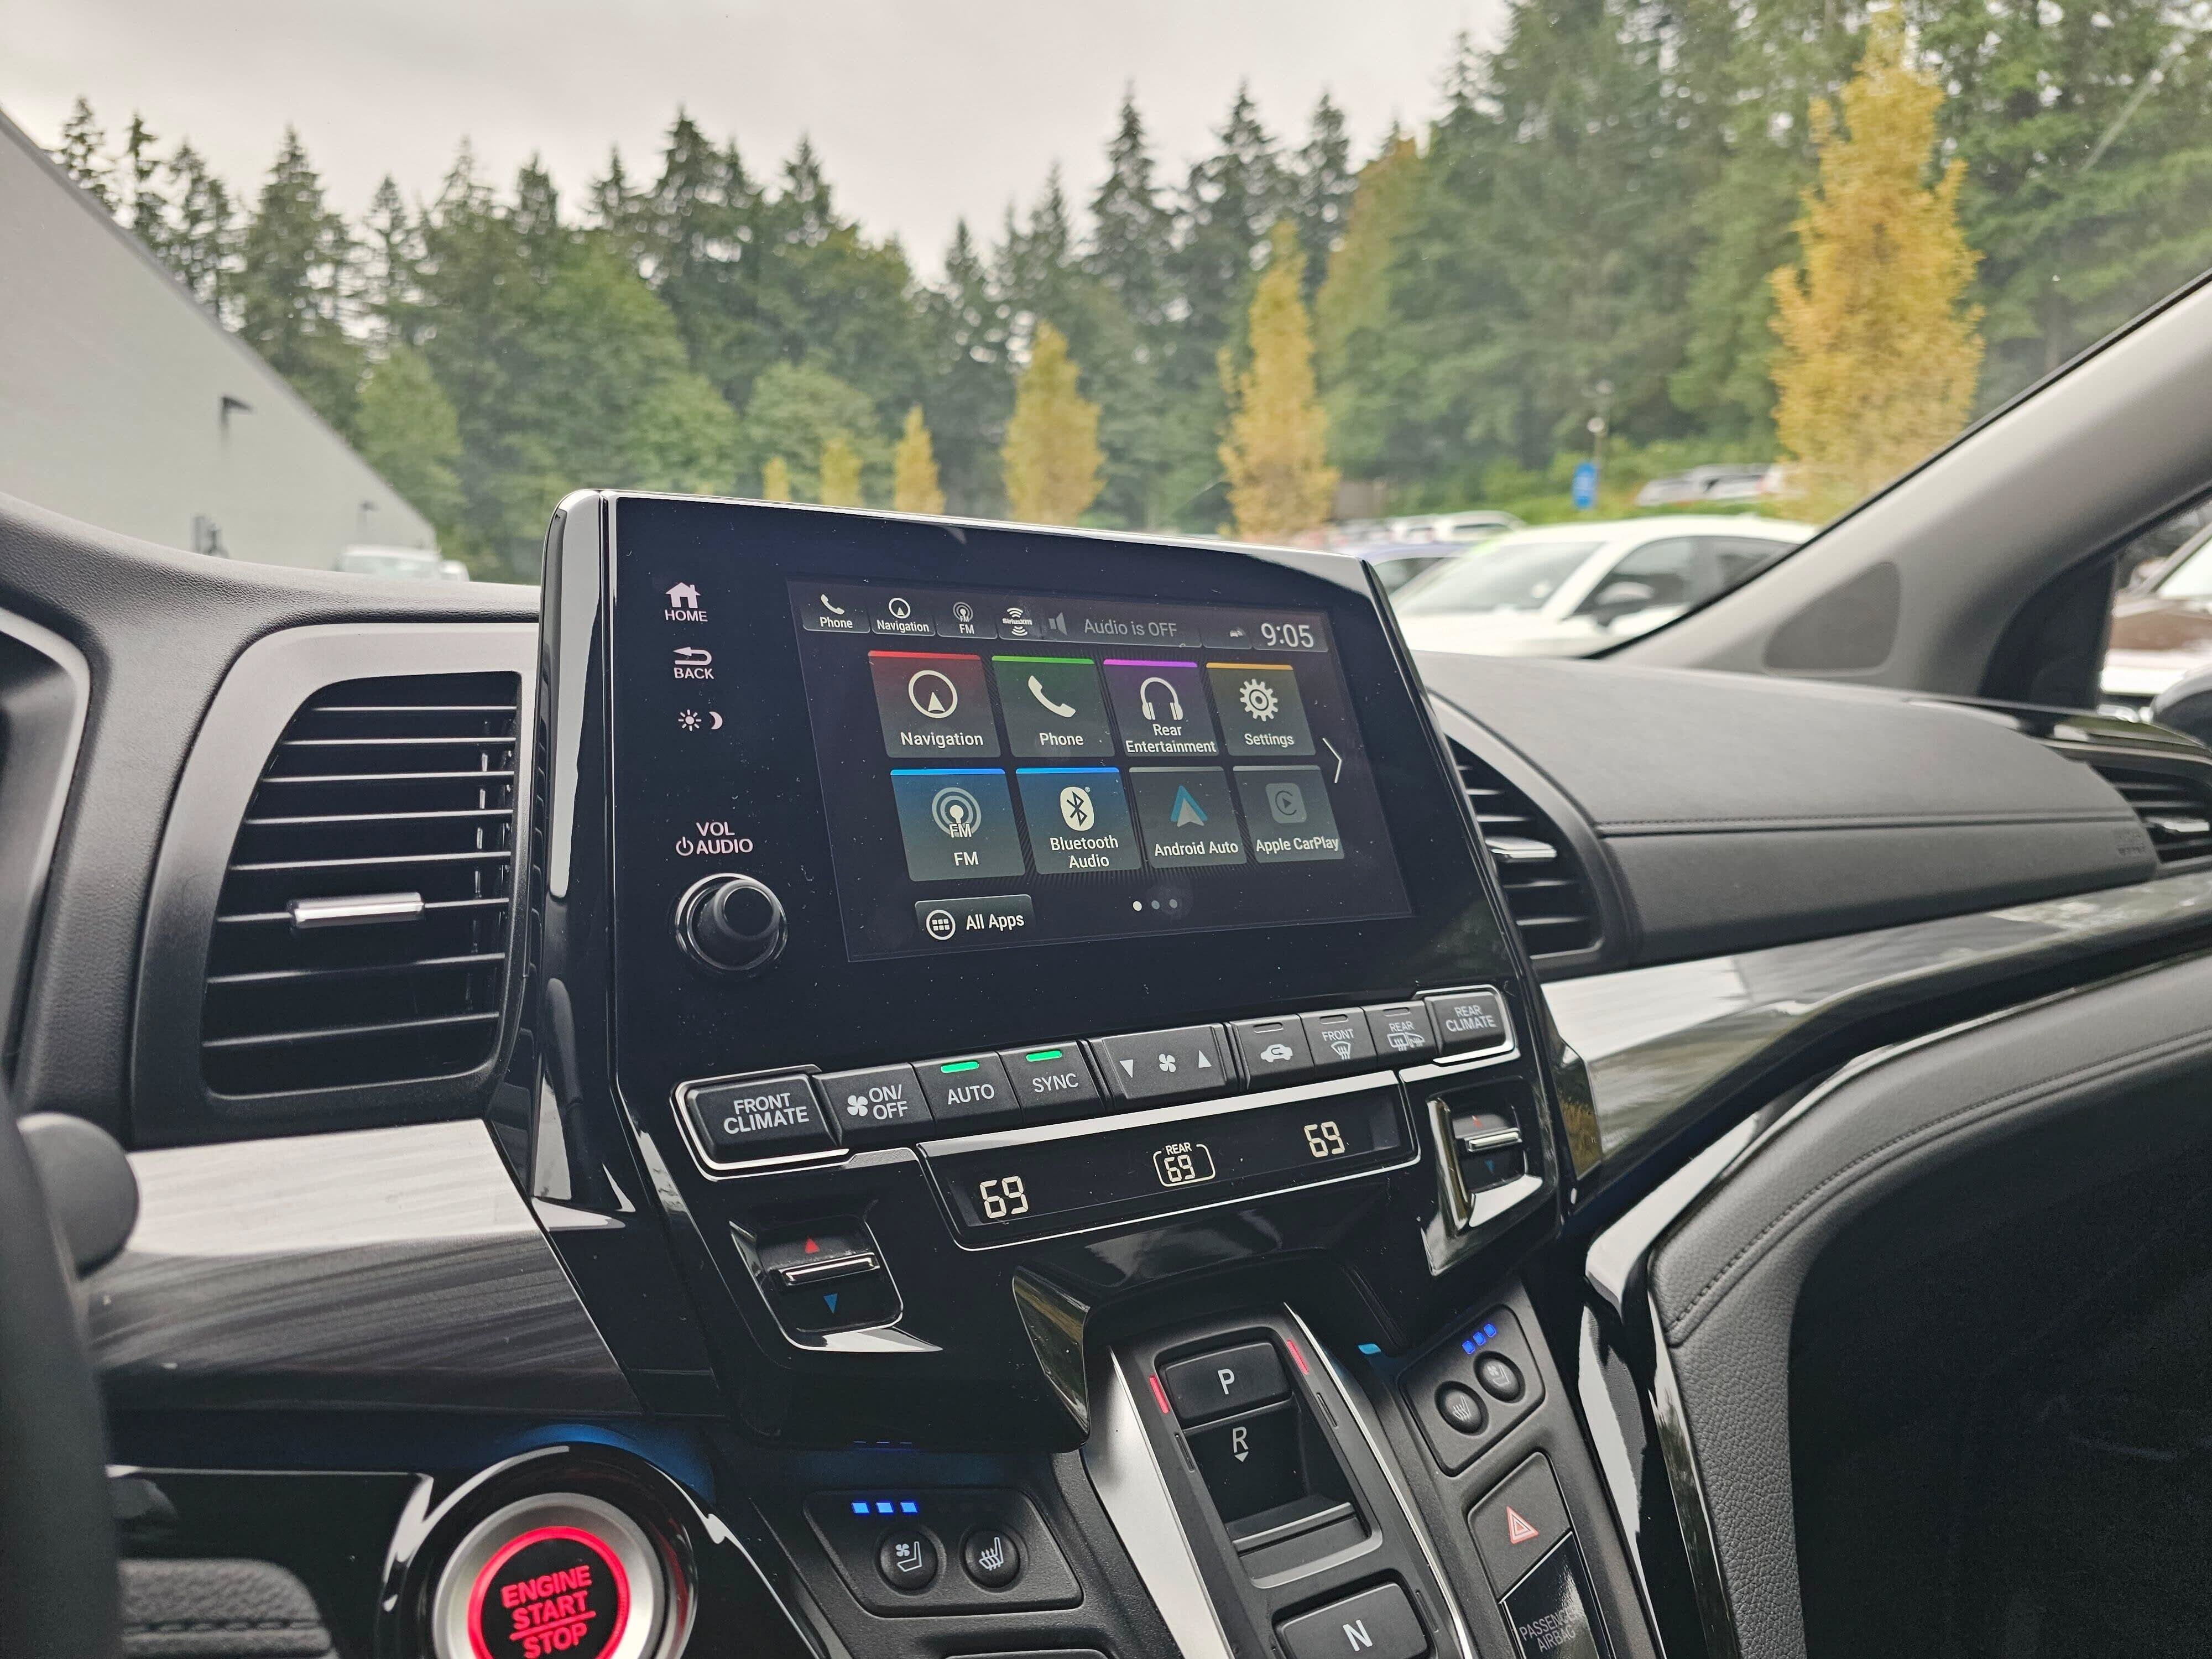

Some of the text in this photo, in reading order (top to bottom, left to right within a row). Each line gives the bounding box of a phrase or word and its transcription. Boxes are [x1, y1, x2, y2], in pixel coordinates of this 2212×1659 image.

[665, 609, 708, 622] HOME
[820, 617, 853, 629] Phone
[877, 619, 930, 633] Navigation
[959, 624, 975, 634] FM
[1084, 619, 1177, 637] Audio is OFF
[1261, 623, 1314, 648] 9:05
[674, 667, 714, 680] BACK
[1153, 724, 1182, 736] Rear
[900, 732, 984, 749] Navigation
[1039, 732, 1084, 746] Phone
[1125, 740, 1217, 754] Entertainment
[1244, 733, 1295, 748] Settings
[696, 822, 735, 837] VOL
[950, 823, 972, 838] FM
[696, 838, 753, 854] AUDIO
[1050, 835, 1119, 851] Bluetooth
[1155, 841, 1239, 857] Android Auto
[1256, 836, 1340, 854] Apple CarPlay
[954, 851, 979, 867] FM
[1068, 854, 1110, 869] Audio
[966, 913, 1025, 931] All Apps
[1454, 1005, 1482, 1018] REAR
[1389, 1020, 1415, 1033] REAR
[1446, 1014, 1496, 1032] CLIMATE
[1322, 1028, 1354, 1041] FRONT
[1032, 1073, 1079, 1093] SYNC
[947, 1083, 995, 1105] AUTO
[733, 1093, 791, 1115] FRONT
[873, 1100, 909, 1120] OFF
[723, 1106, 810, 1135] CLIMATE
[1304, 1121, 1345, 1157] 69
[1165, 1142, 1192, 1155] REAR
[1164, 1154, 1196, 1183] 69
[980, 1176, 1029, 1219] 69
[1218, 1368, 1235, 1395] P
[1232, 1426, 1248, 1454] R
[500, 1565, 592, 1609] ENGINE
[512, 1590, 588, 1630] START
[1519, 1604, 1585, 1641] PASSENGE
[523, 1623, 587, 1659] STOP
[1342, 1618, 1374, 1652] N
[1537, 1624, 1576, 1653] AIRBAG
